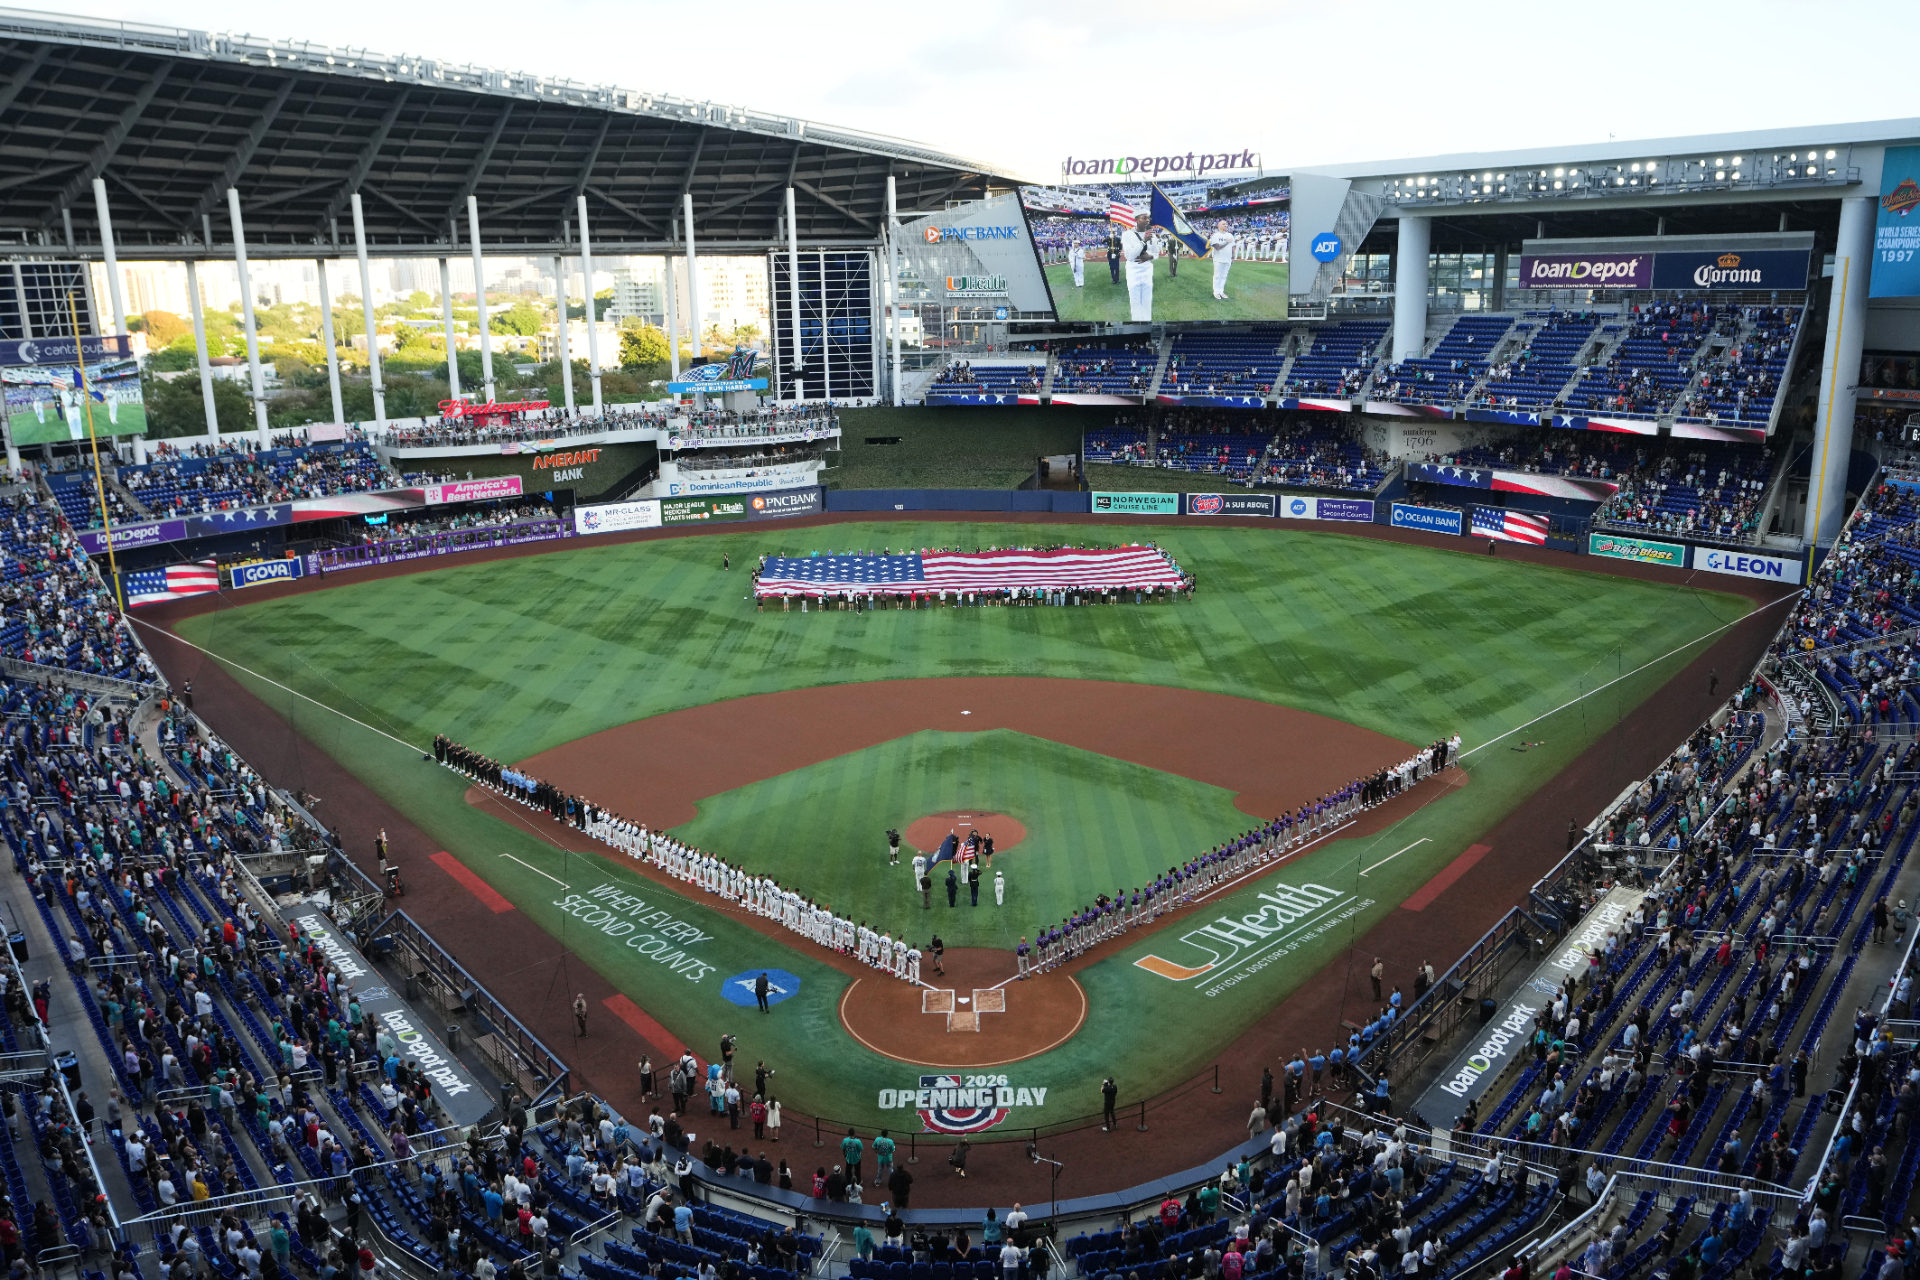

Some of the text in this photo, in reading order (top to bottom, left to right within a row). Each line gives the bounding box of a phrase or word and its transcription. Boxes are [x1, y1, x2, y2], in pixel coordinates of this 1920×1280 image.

[1066, 149, 1255, 177] loanDepot park
[1879, 227, 1899, 238] WORLD
[1315, 241, 1338, 253] ADT
[1881, 250, 1914, 262] 1997
[1531, 258, 1638, 282] loanDepot
[1694, 265, 1762, 288] Corona
[996, 309, 1006, 318] 42
[438, 398, 550, 419] Budweiser
[1406, 437, 1433, 449] 1796
[533, 449, 600, 470] AMERANT
[553, 468, 584, 482] BANK
[455, 479, 508, 492] America's
[446, 486, 518, 502] Best Network
[1113, 496, 1174, 504] NORWEGIAN
[663, 501, 705, 510] MAJOR LEAGUE
[1247, 501, 1269, 509] ABOVE
[1323, 502, 1359, 511] When Every
[664, 514, 685, 522] STARTS
[1323, 509, 1371, 519] Second Counts.
[1405, 512, 1458, 528] OCEAN BANK
[1612, 544, 1673, 560] Baja Blast
[246, 564, 288, 581] GOYA
[1724, 555, 1783, 577] LEON
[587, 883, 714, 946] WHEN EVERY
[553, 894, 716, 983] SECOND COUNTS.
[1551, 901, 1626, 971] loanDepot park
[296, 913, 367, 979] loanDepot park
[1205, 898, 1376, 998] OFFICIAL DOCTORS OF THE MIAMI MARLINS
[381, 1010, 472, 1097] loanDepot park
[1440, 1003, 1537, 1097] loanDepot park
[965, 1075, 1008, 1087] 2026
[878, 1087, 1047, 1109] OPENING DAY
